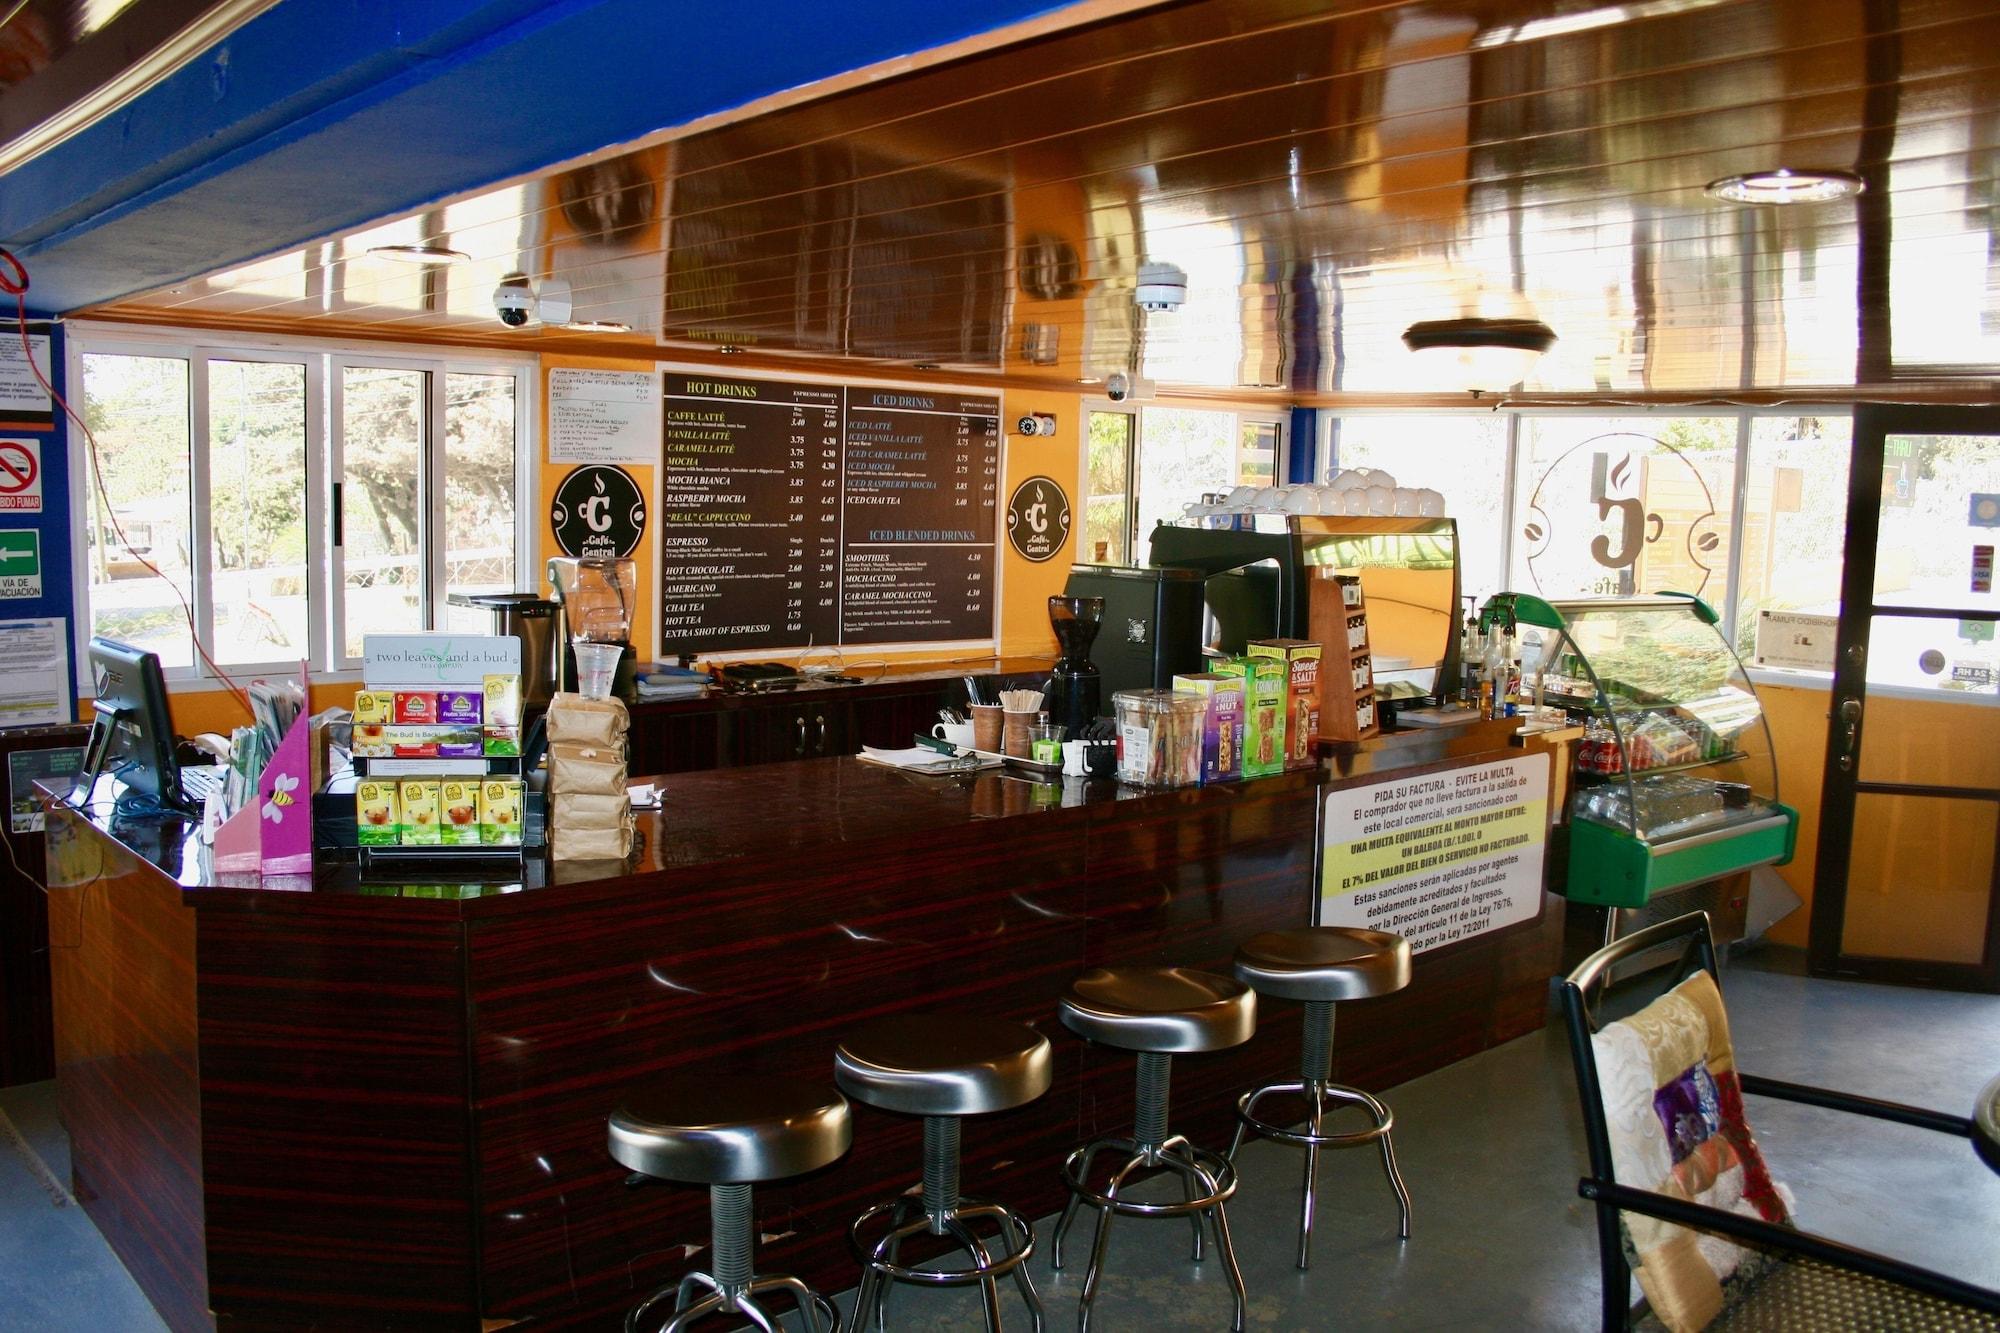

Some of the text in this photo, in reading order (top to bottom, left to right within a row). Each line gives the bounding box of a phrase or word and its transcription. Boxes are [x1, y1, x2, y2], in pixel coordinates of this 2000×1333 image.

[686, 381, 757, 398] HOT DRINKS
[872, 394, 935, 409] ICED DRINKS
[668, 411, 696, 420] CAFFE
[668, 430, 804, 444] VANILLA 3.75
[868, 434, 900, 442] VANILLA
[667, 444, 804, 456] CARAMEL 3.75
[868, 452, 904, 460] CARAMEL
[668, 457, 804, 470] MOCHA 3.75
[667, 476, 730, 486] MOCHA BIANCA
[868, 480, 909, 488] RASPBERRY
[910, 482, 936, 490] MOCHA
[16, 496, 40, 508] FUMAR
[666, 494, 746, 504] RASPBERRY MOCHA
[847, 496, 900, 505] ICED CHAI TEA
[698, 513, 751, 522] CAPPUCCINO
[588, 534, 610, 546] Café
[870, 530, 976, 541] ICED BLENDED DRINKS
[1032, 534, 1046, 544] Café
[666, 537, 708, 546] ESPRESSO
[582, 547, 616, 558] Central
[1027, 544, 1050, 552] Central
[845, 554, 890, 562] SMOOTHIES
[666, 566, 735, 575] HOT CHOCOLATE
[3, 578, 28, 588] VÍA DE
[845, 574, 896, 583] MOCHACCINO
[666, 584, 716, 593] AMERICANO
[845, 591, 932, 600] CARAMEL MOCHACCINO
[666, 603, 704, 612] CHAI TEA
[666, 616, 701, 625] HOT TEA
[666, 630, 692, 638] EXTRA
[694, 628, 716, 636] SHOT
[730, 624, 770, 634] ESPRESSO
[787, 623, 801, 632] 0.60
[377, 650, 508, 662] two leaves and a bud
[1292, 660, 1318, 672] Sweet
[1296, 671, 1317, 682] SALTY
[1256, 680, 1282, 694] CRUNCHY
[1216, 693, 1237, 703] FRUIT
[1220, 702, 1237, 711] NUT
[1374, 766, 1514, 803] PIDA SU FACTURA EVITE LA MULTA
[1354, 809, 1362, 820] El
[1364, 800, 1408, 818] comprador
[1409, 798, 1424, 811] que
[1424, 797, 1434, 806] no
[1436, 790, 1454, 804] lleve
[1455, 786, 1481, 800] factura
[1489, 782, 1496, 792] la
[1497, 778, 1518, 791] salida
[1518, 776, 1528, 786] de
[1363, 794, 1518, 834] este local comercial, será sancionado con
[1351, 806, 1527, 854] UNA MULTA EQUIVALENTE AL MONTO MAYOR ENTRE:
[1402, 830, 1482, 858] UN BALBOA O
[1342, 833, 1530, 888] EL 7% DEL VALOR DEL BIEN O SERVICIO NO FACTURADO.
[1354, 854, 1519, 906] Estas sanciones serán aplicadas por agentes
[1367, 872, 1507, 918] debidamente acreditados y facultados
[1384, 887, 1504, 928] la Dirección General de Ingresos.
[1404, 926, 1416, 938] del
[1449, 912, 1458, 922] 11
[1460, 910, 1469, 920] de
[1470, 906, 1477, 917] la
[1478, 904, 1492, 917] Ley
[1493, 898, 1513, 911] 76/76,
[1425, 918, 1490, 949] por la Ley 72/2011
